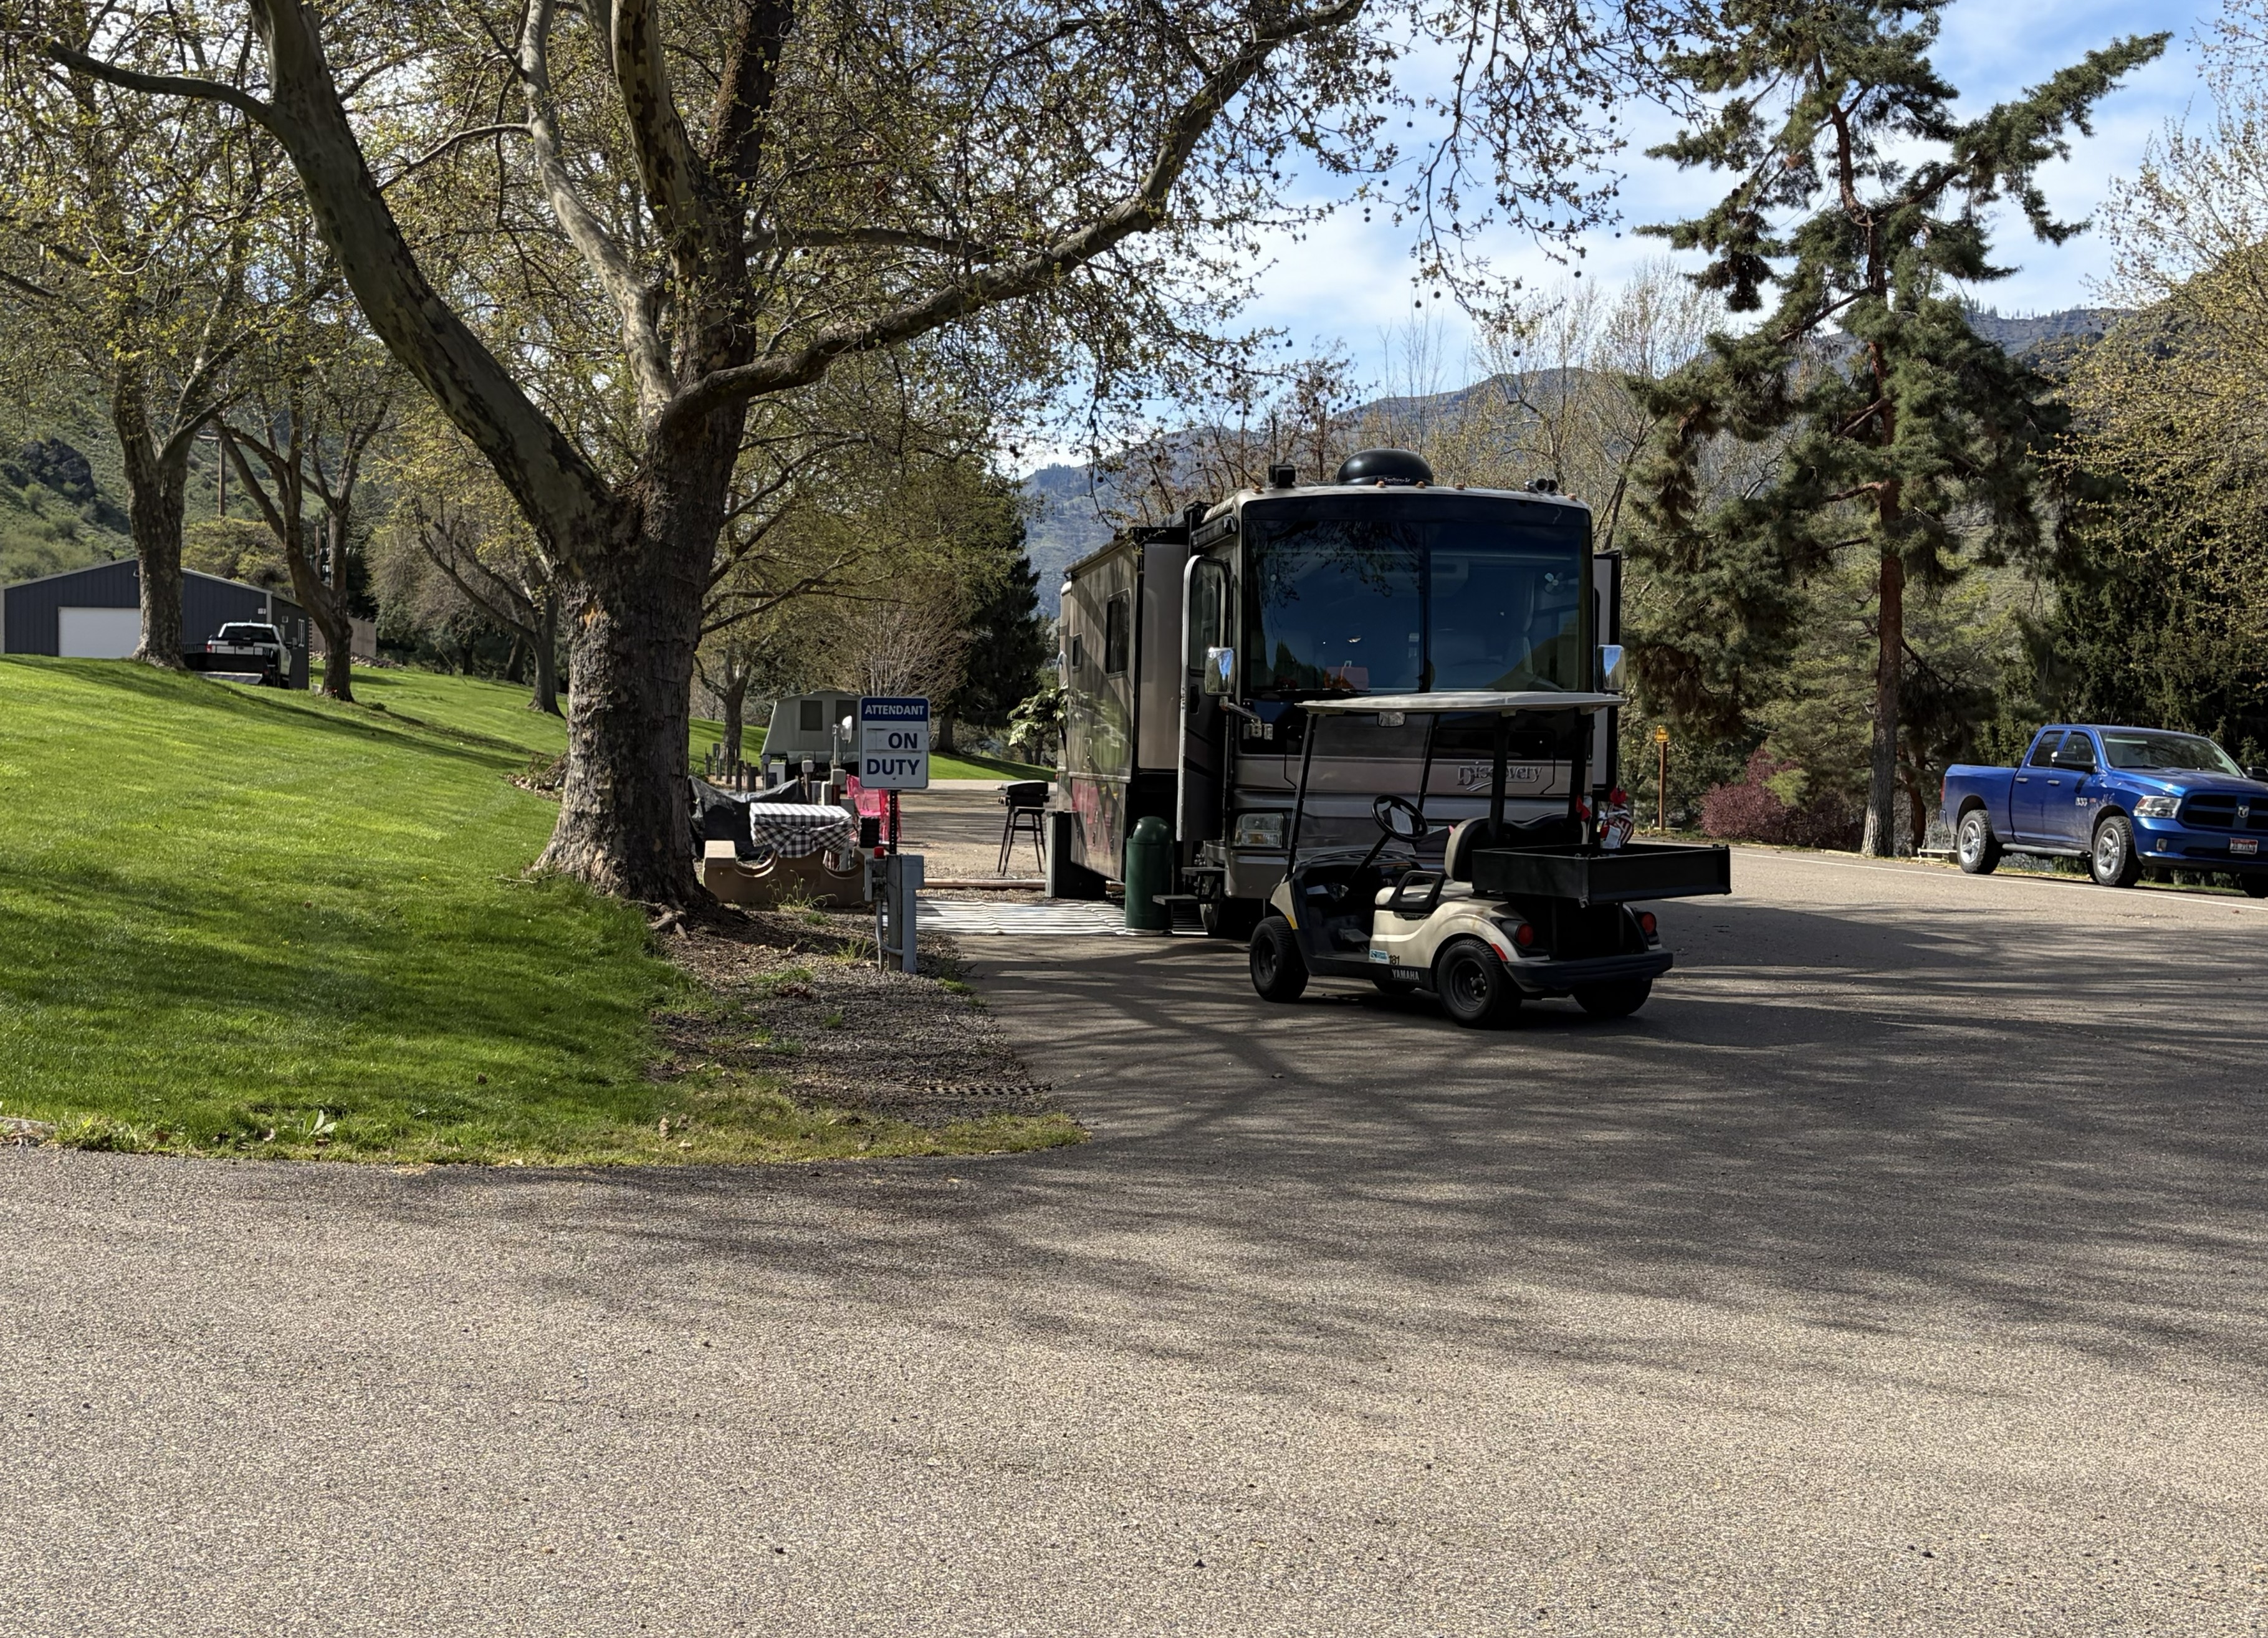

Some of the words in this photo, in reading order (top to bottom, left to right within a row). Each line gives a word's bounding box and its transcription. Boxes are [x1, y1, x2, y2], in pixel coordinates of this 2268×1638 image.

[864, 704, 925, 716] ATTENDANT
[888, 732, 918, 749] ON
[866, 758, 921, 775] DUTY
[1392, 968, 1420, 982] YAMAHA
